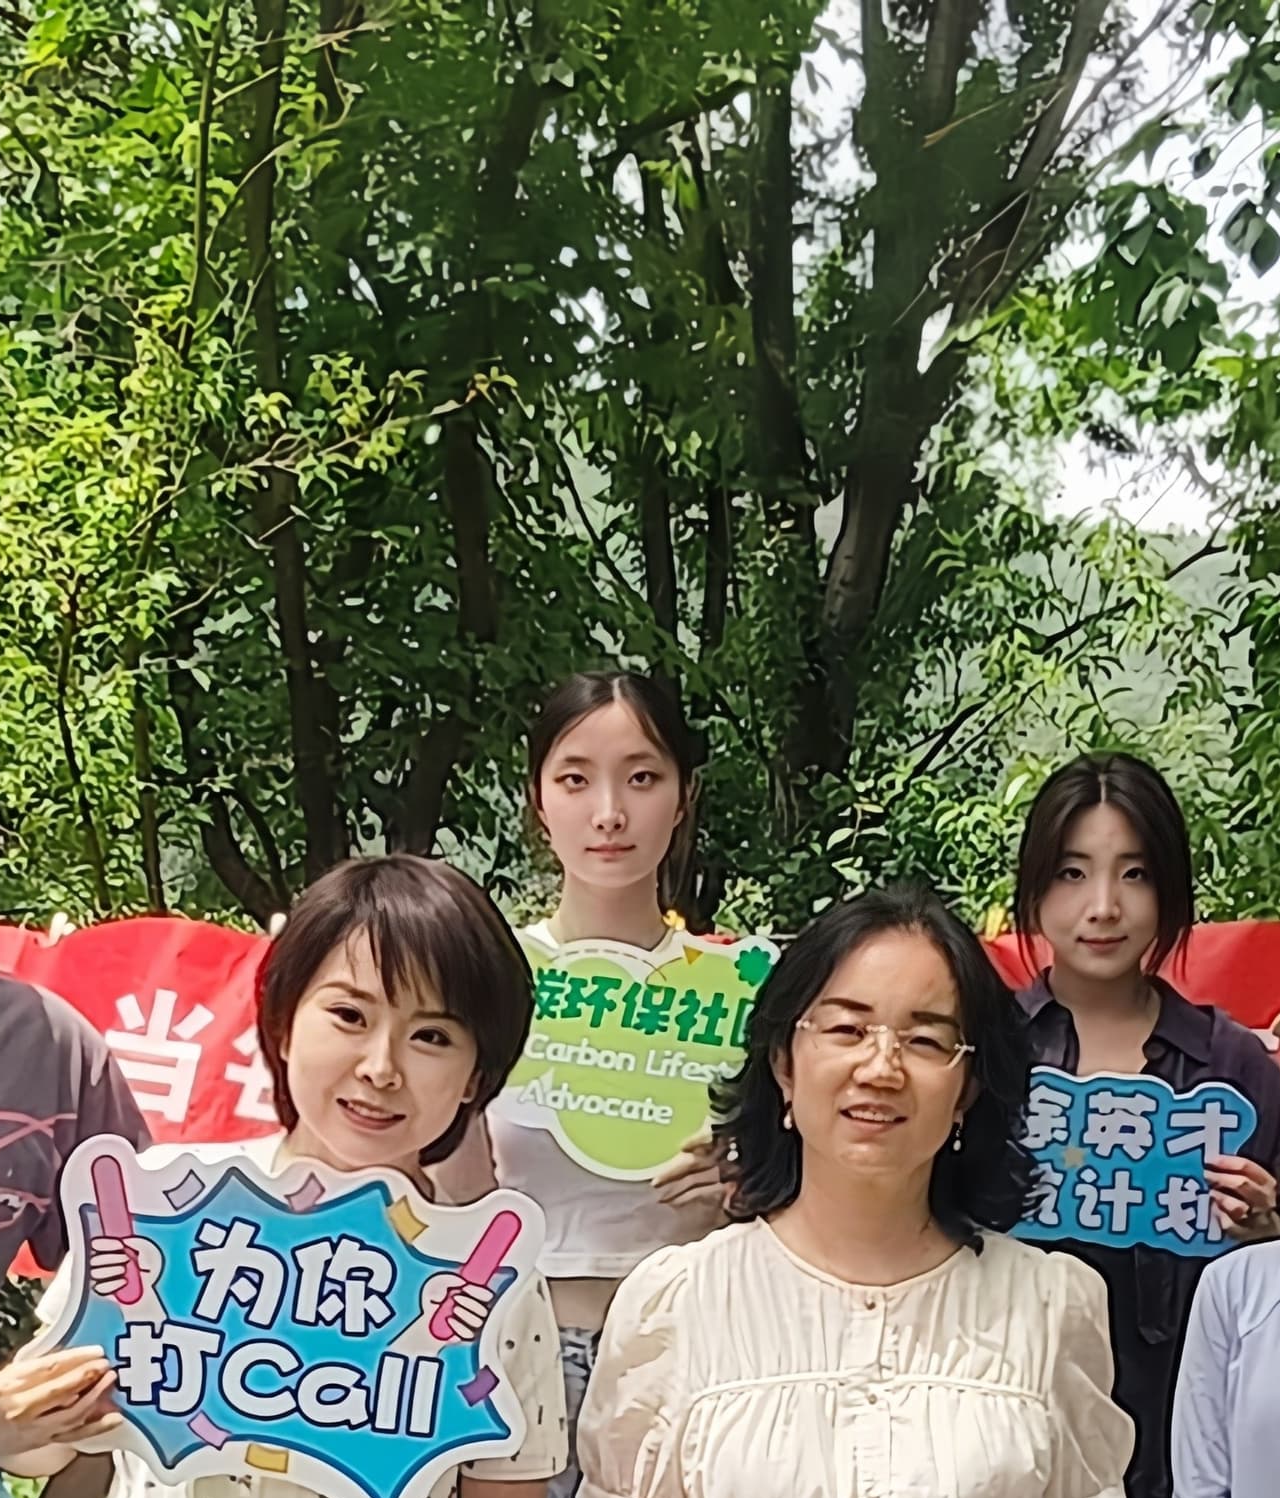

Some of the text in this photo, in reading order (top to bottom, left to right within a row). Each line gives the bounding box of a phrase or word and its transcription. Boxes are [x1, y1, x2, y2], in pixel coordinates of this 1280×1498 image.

[524, 1032, 636, 1073] Carbon
[519, 1078, 674, 1125] Advocate
[192, 1217, 397, 1337] 为你
[117, 1321, 444, 1438] 打Call
